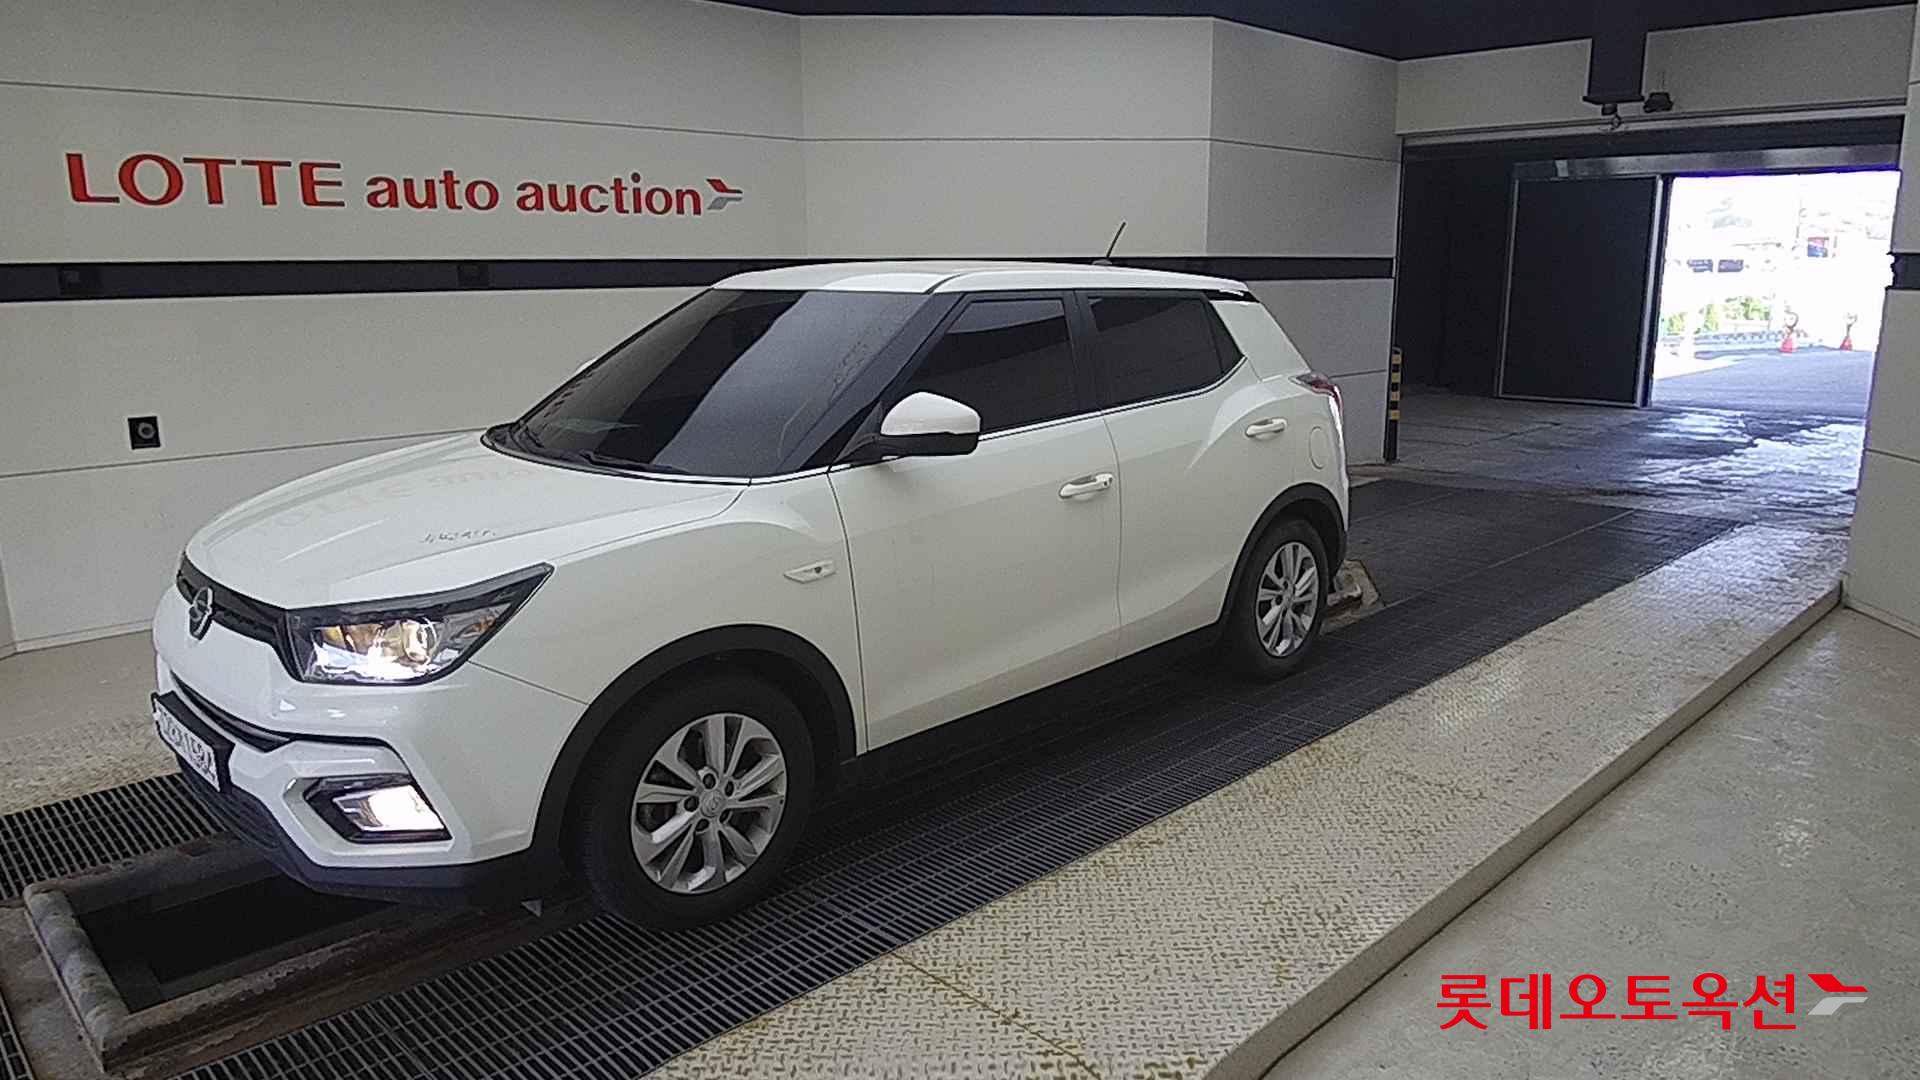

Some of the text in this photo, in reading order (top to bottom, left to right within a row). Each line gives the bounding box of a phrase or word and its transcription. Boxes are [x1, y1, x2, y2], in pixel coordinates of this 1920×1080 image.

[66, 153, 703, 216] LOTTE auto auction
